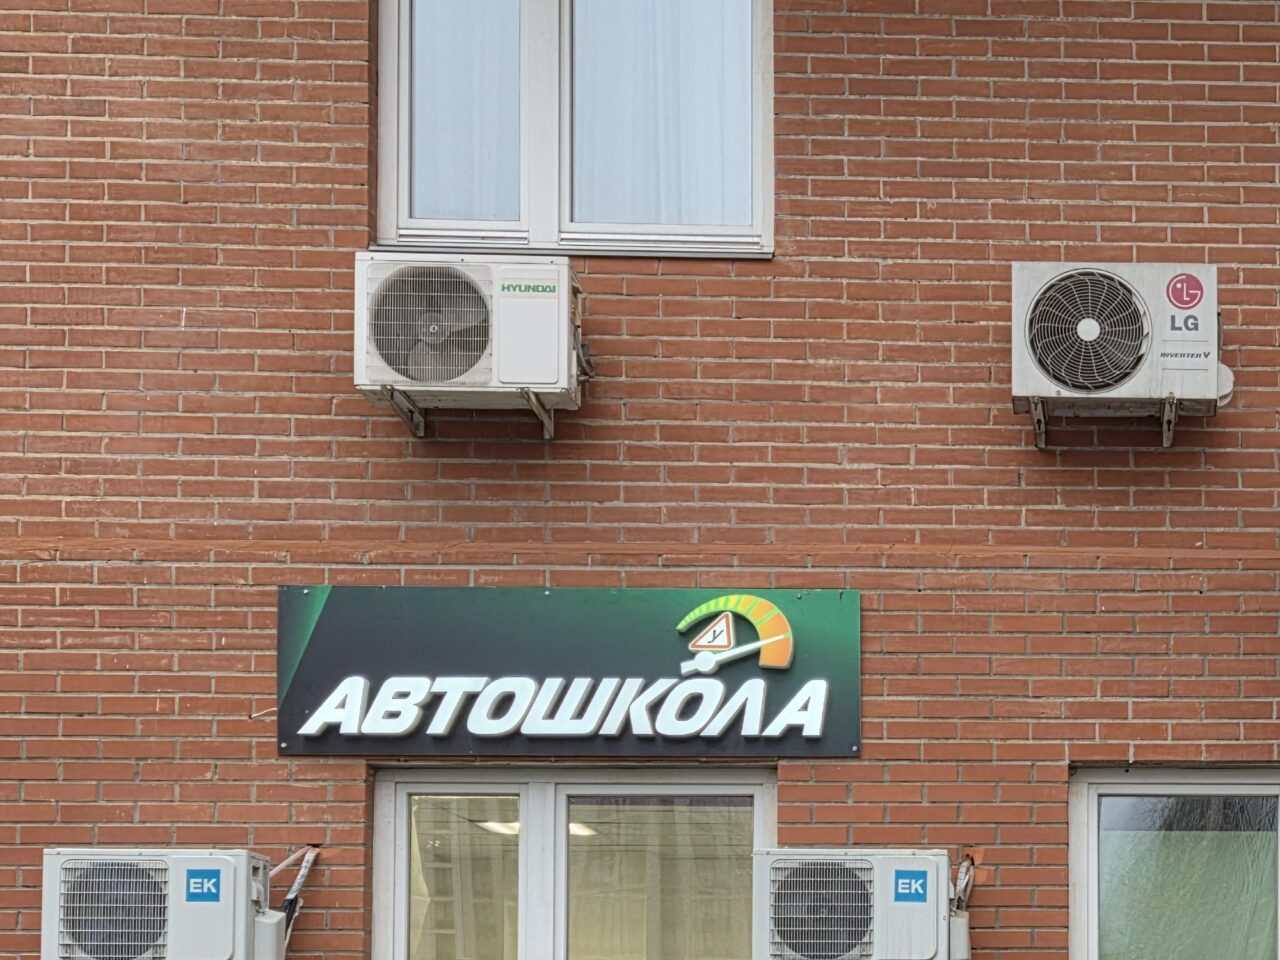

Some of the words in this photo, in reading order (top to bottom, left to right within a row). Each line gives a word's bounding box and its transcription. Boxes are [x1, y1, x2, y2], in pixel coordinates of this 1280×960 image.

[501, 283, 556, 293] HYUNDAI
[1170, 314, 1199, 332] LG
[1203, 351, 1211, 359] V
[298, 675, 828, 739] АВТОШКОЛА
[189, 878, 217, 893] EK
[898, 879, 924, 894] EK
